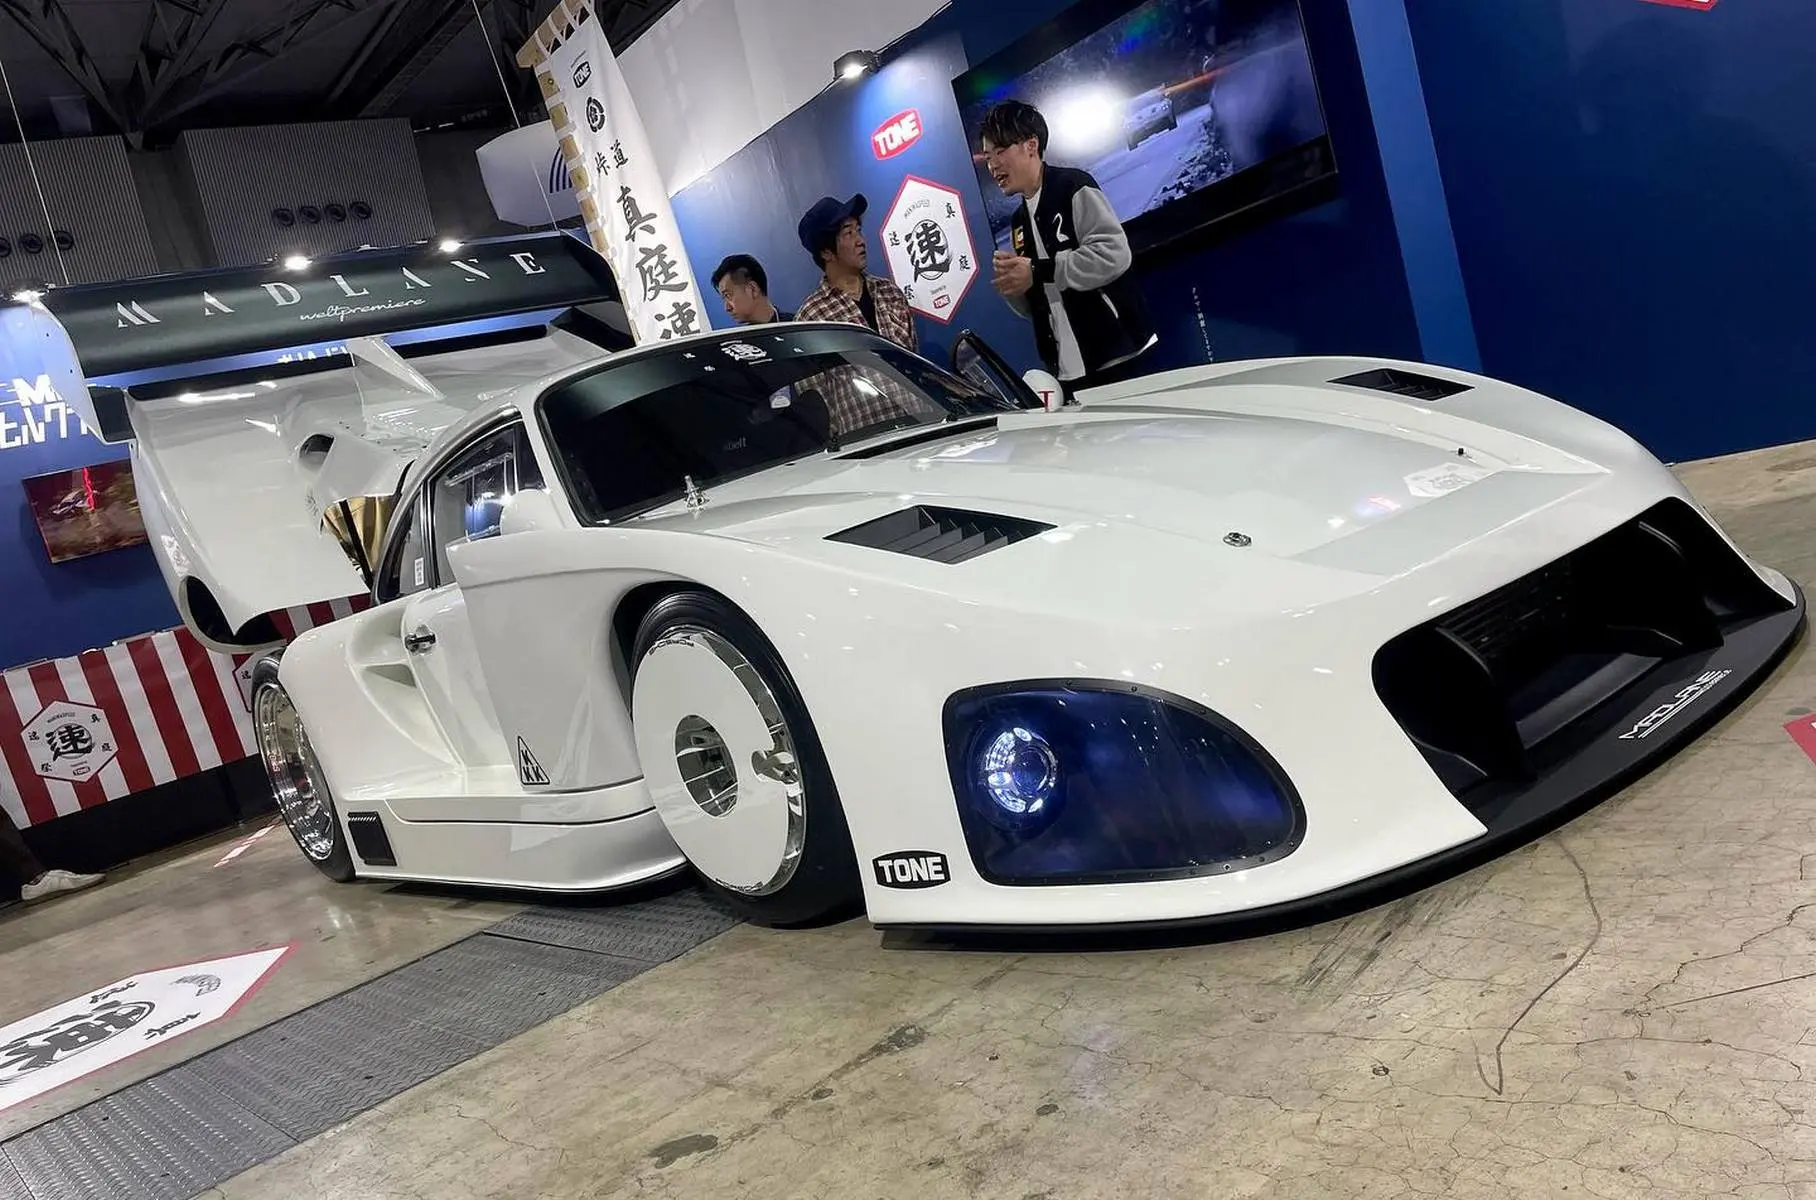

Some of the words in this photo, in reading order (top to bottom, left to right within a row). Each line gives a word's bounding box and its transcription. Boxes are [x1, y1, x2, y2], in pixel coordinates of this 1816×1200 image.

[873, 111, 921, 156] TONE
[903, 222, 951, 283] 速
[300, 299, 427, 322] weltpremiere
[12, 374, 64, 406] M
[45, 725, 92, 761] 速
[878, 856, 946, 883] TONE
